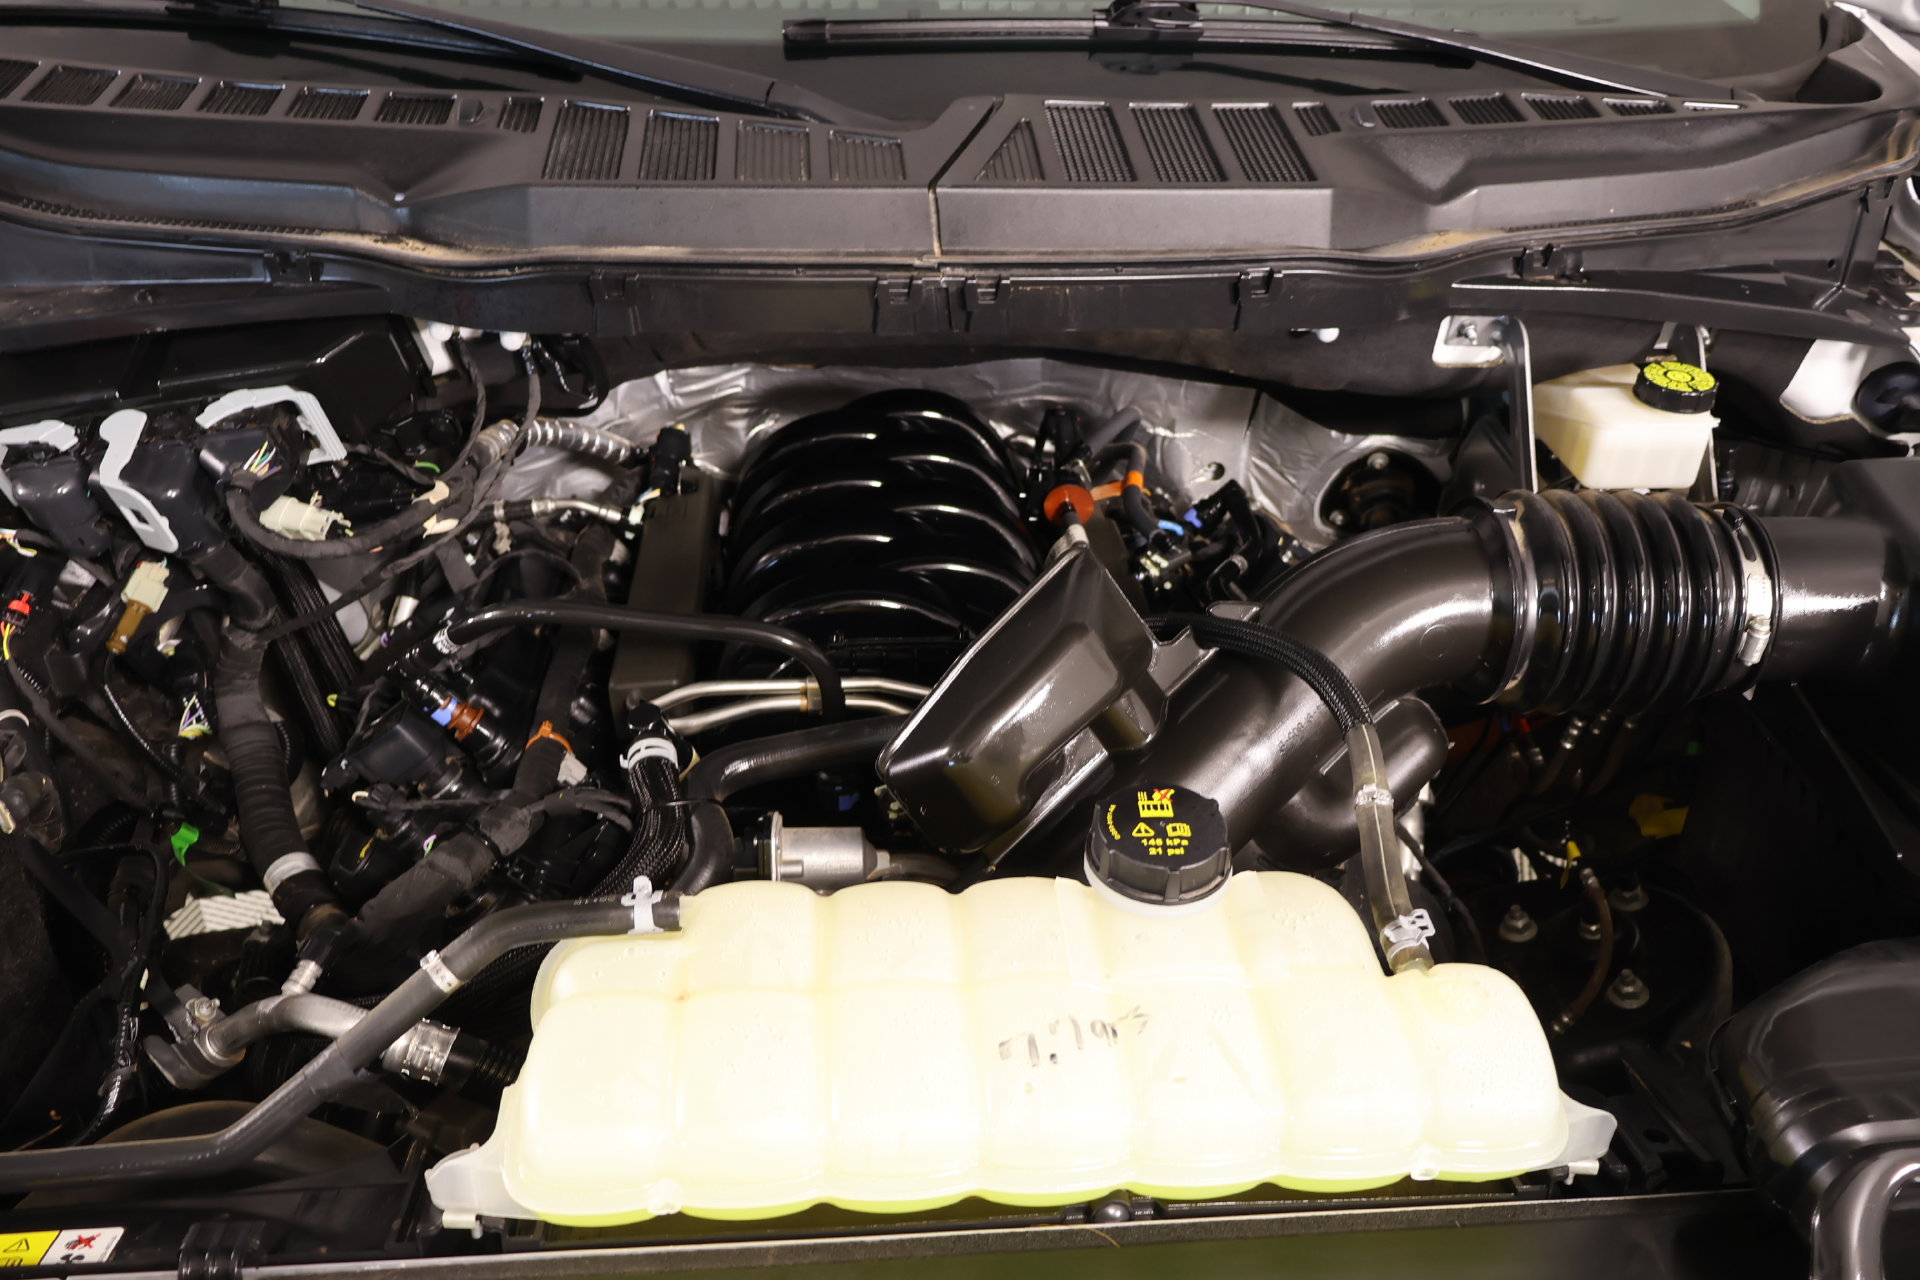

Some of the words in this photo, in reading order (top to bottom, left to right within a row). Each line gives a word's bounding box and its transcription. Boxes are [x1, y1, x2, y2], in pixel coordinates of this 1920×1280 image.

[1166, 838, 1189, 846] kPa
[1148, 847, 1163, 855] 21
[1167, 847, 1184, 856] psi
